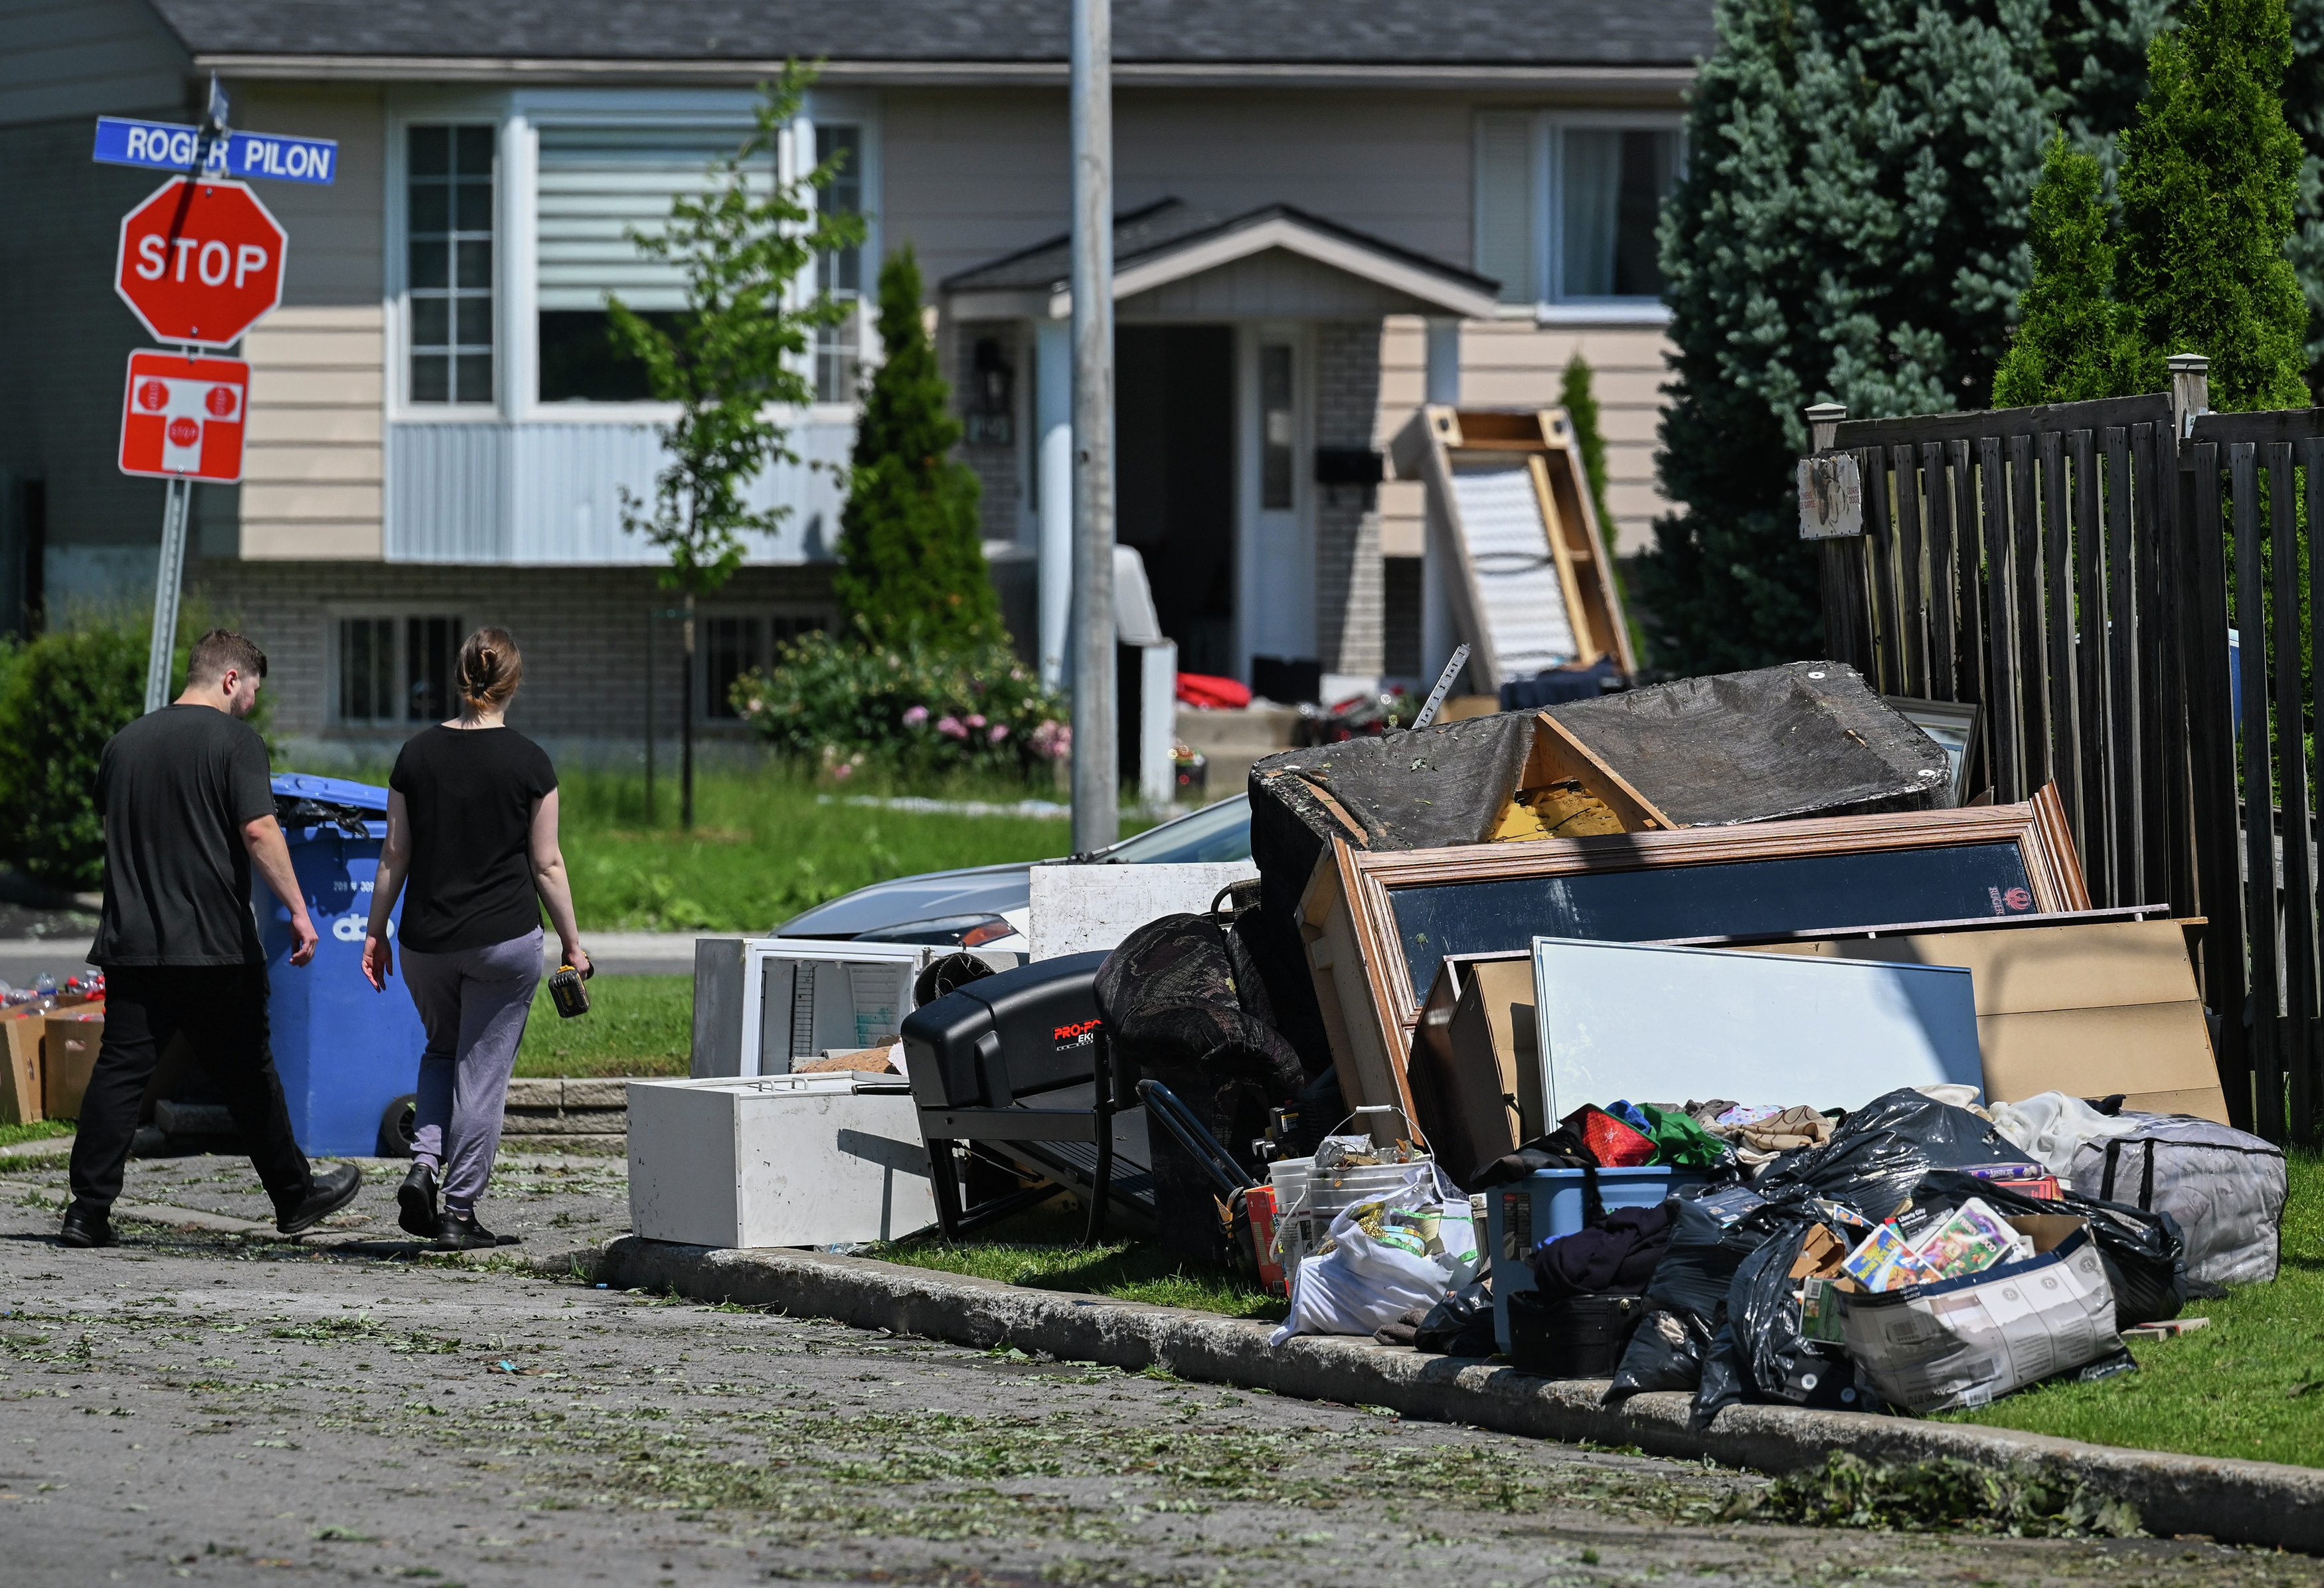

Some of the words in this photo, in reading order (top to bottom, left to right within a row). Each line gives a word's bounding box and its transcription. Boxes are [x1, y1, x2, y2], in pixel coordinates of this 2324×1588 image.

[244, 139, 331, 179] PILON
[135, 233, 268, 289] STOP
[169, 426, 198, 439] STOP
[1988, 887, 2005, 915] RUGER
[1078, 1033, 1093, 1043] EK
[1897, 1212, 1916, 1223] Liberty
[1914, 1207, 1926, 1217] City
[1908, 1395, 1924, 1406] BTU
[1924, 1387, 1951, 1403] 5,000
